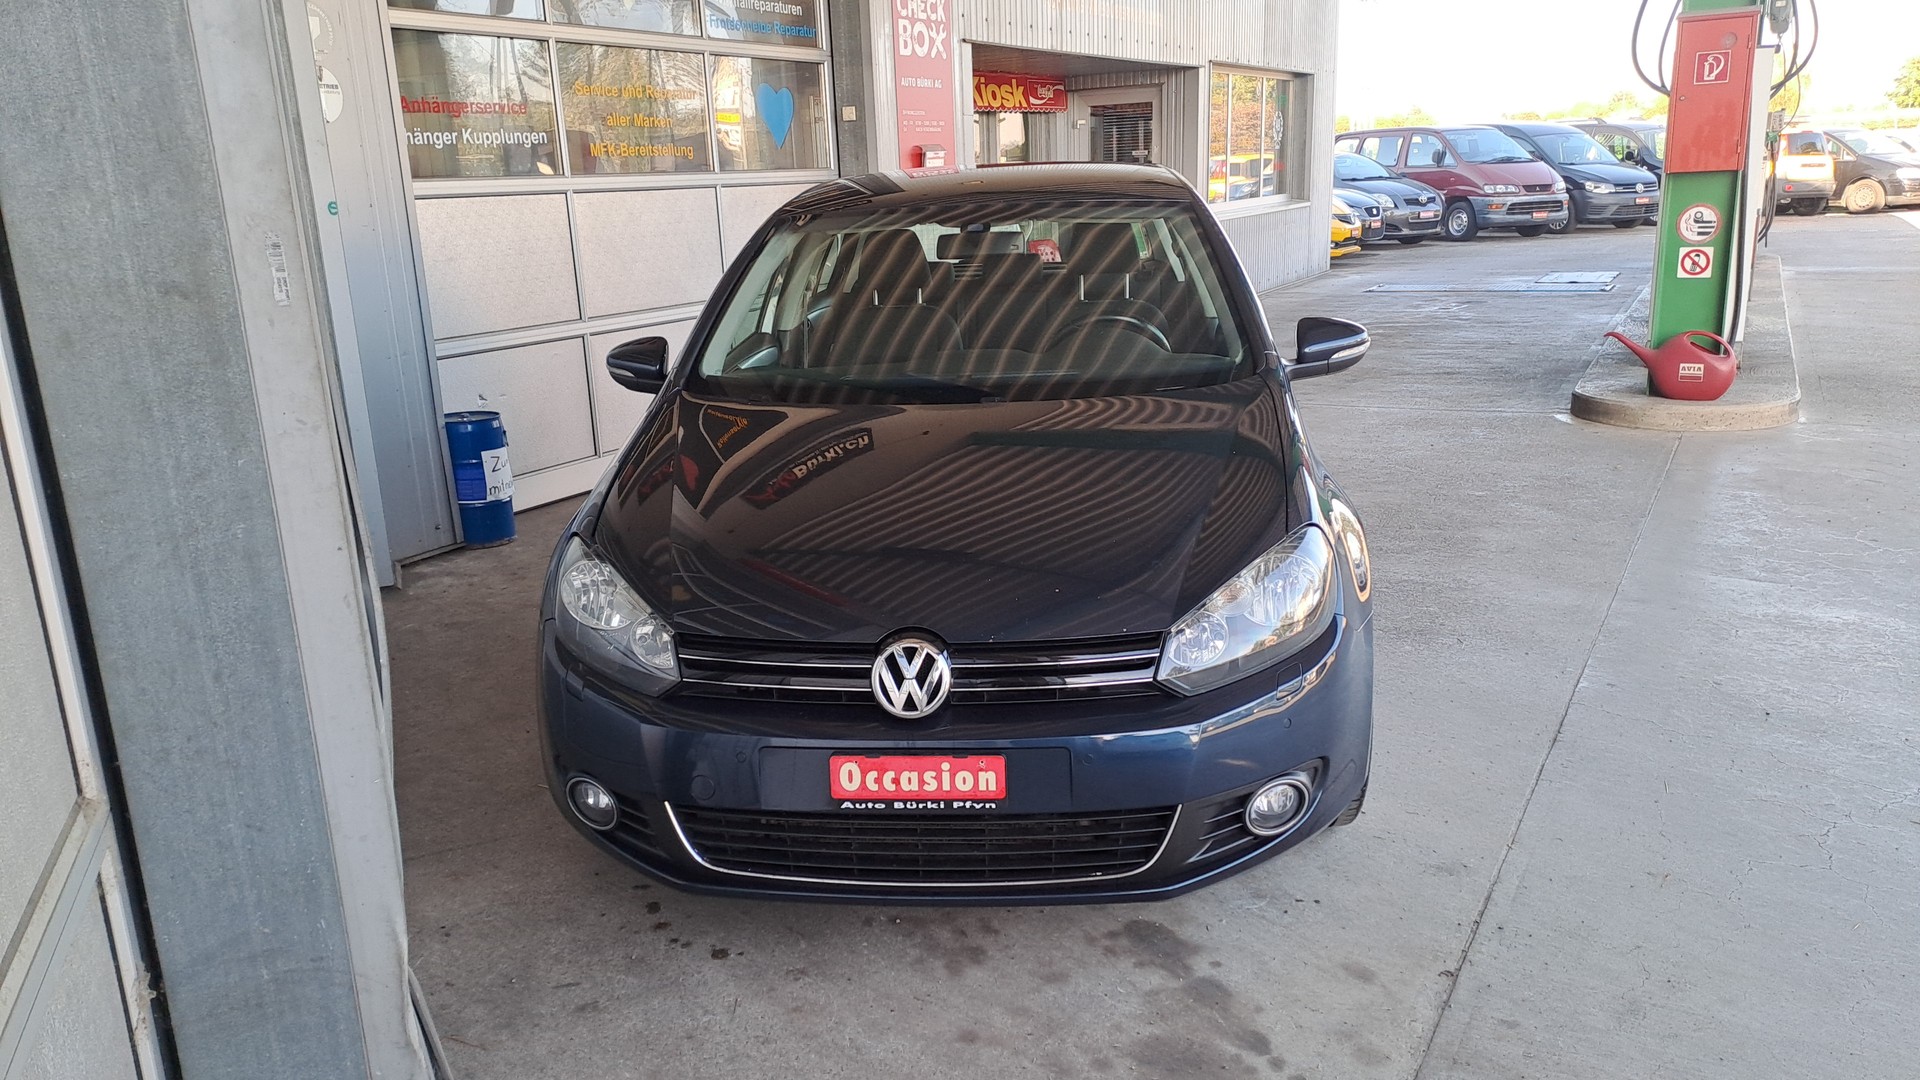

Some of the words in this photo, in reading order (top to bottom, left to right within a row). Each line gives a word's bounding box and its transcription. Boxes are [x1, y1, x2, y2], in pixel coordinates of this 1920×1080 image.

[897, 0, 946, 22] CHECK
[774, 20, 817, 38] Reparatur
[898, 18, 947, 60] BOX
[575, 81, 618, 97] Service
[622, 84, 643, 98] und
[646, 85, 697, 100] Reparatur
[901, 77, 916, 87] AUTO
[917, 76, 934, 88] BÜRKI
[935, 79, 942, 88] AG
[973, 76, 1028, 107] Kiosk
[401, 95, 528, 118] Anhängerservice
[607, 112, 632, 126] aller
[634, 113, 673, 128] Marken
[462, 128, 548, 149] Kupplungen
[590, 142, 694, 159] MFK-Bereitstellung
[839, 761, 997, 792] Occasion
[840, 801, 886, 809] Auto
[893, 801, 944, 809] Bürki
[953, 801, 997, 810] Pfyn
